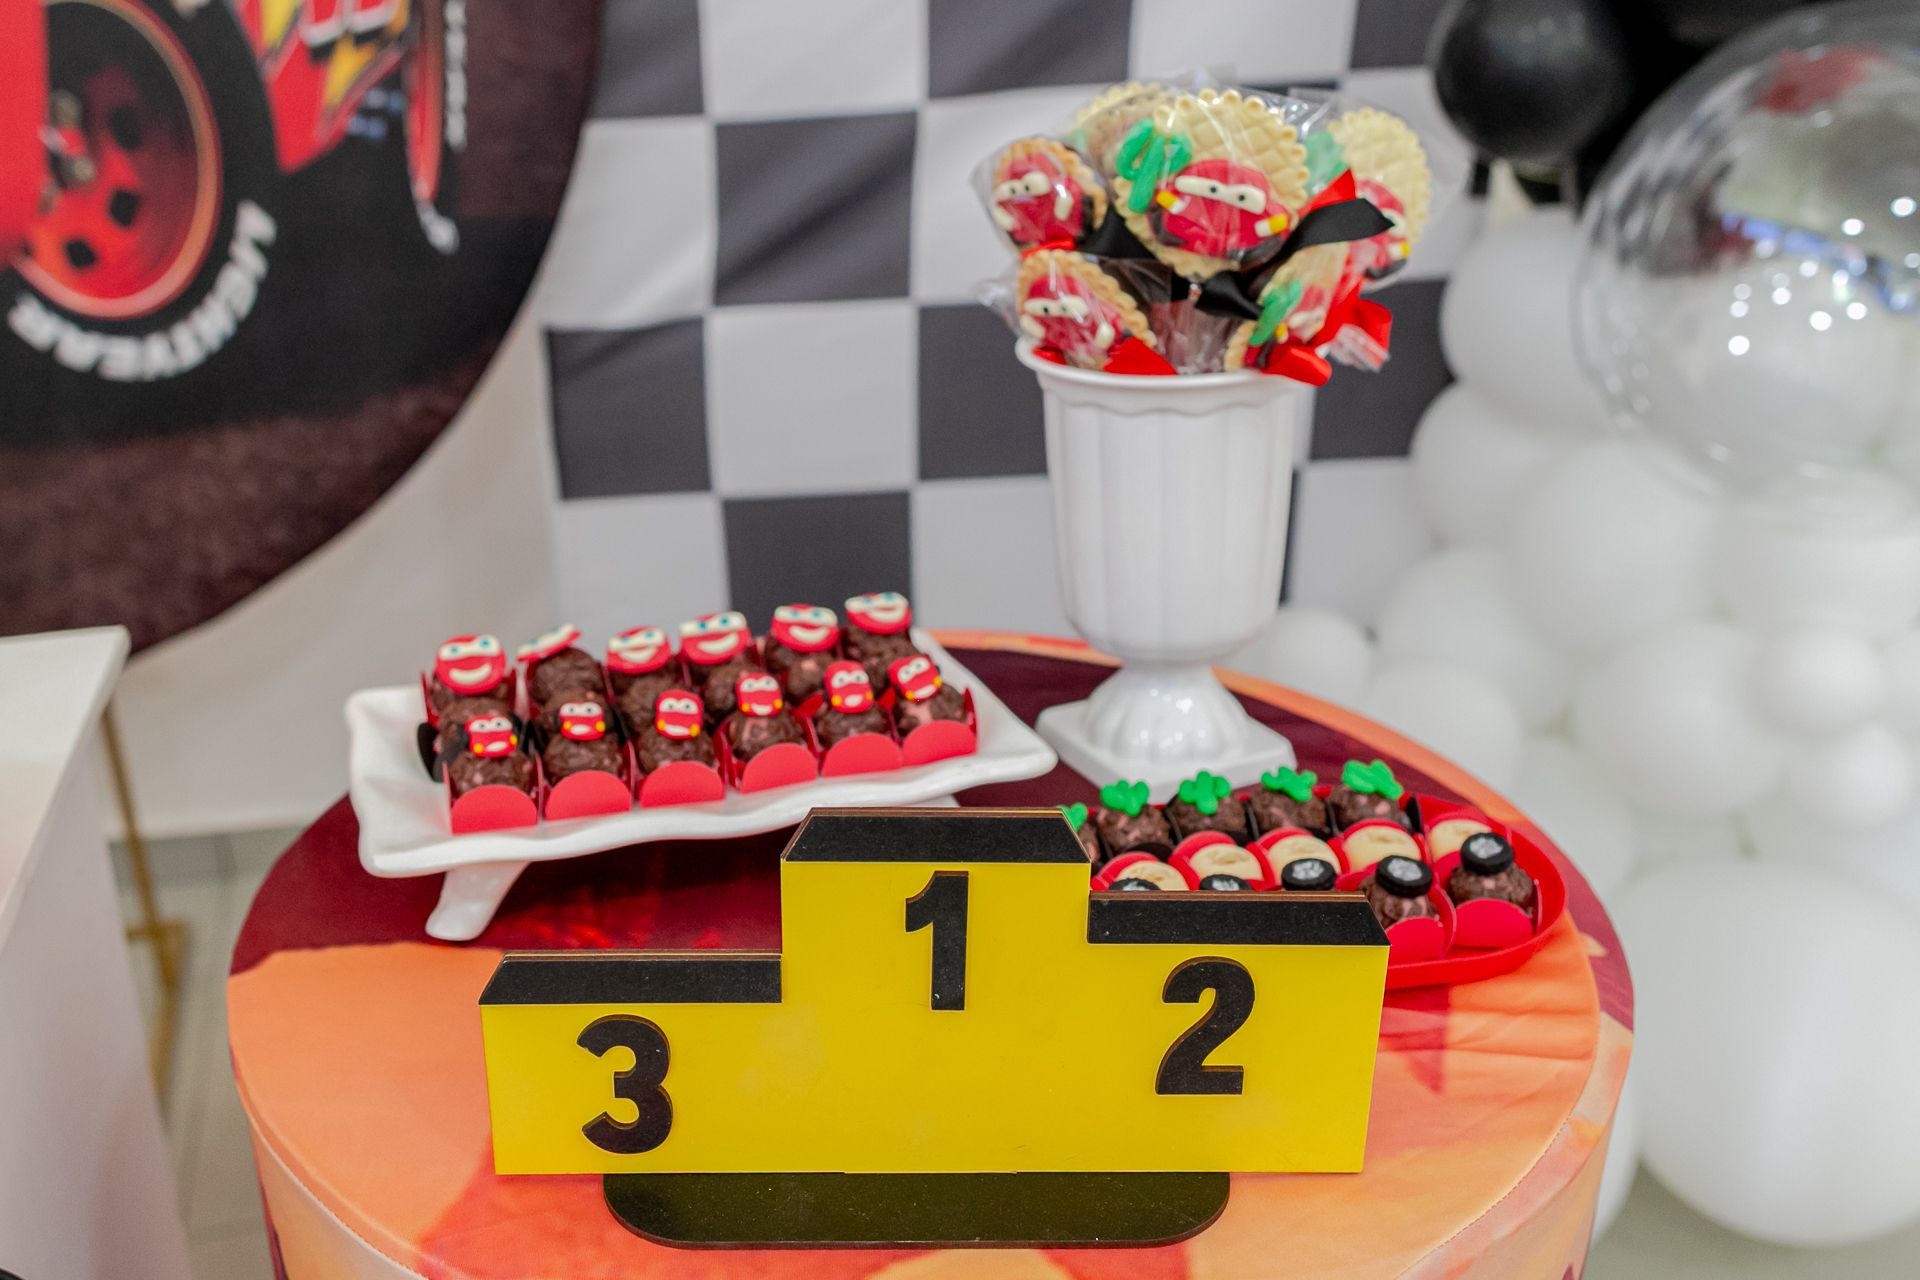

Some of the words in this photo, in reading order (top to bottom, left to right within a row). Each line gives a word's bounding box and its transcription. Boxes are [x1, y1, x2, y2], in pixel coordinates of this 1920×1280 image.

[904, 871, 969, 1011] 1
[576, 1014, 674, 1154] 3
[1155, 956, 1256, 1095] 2
